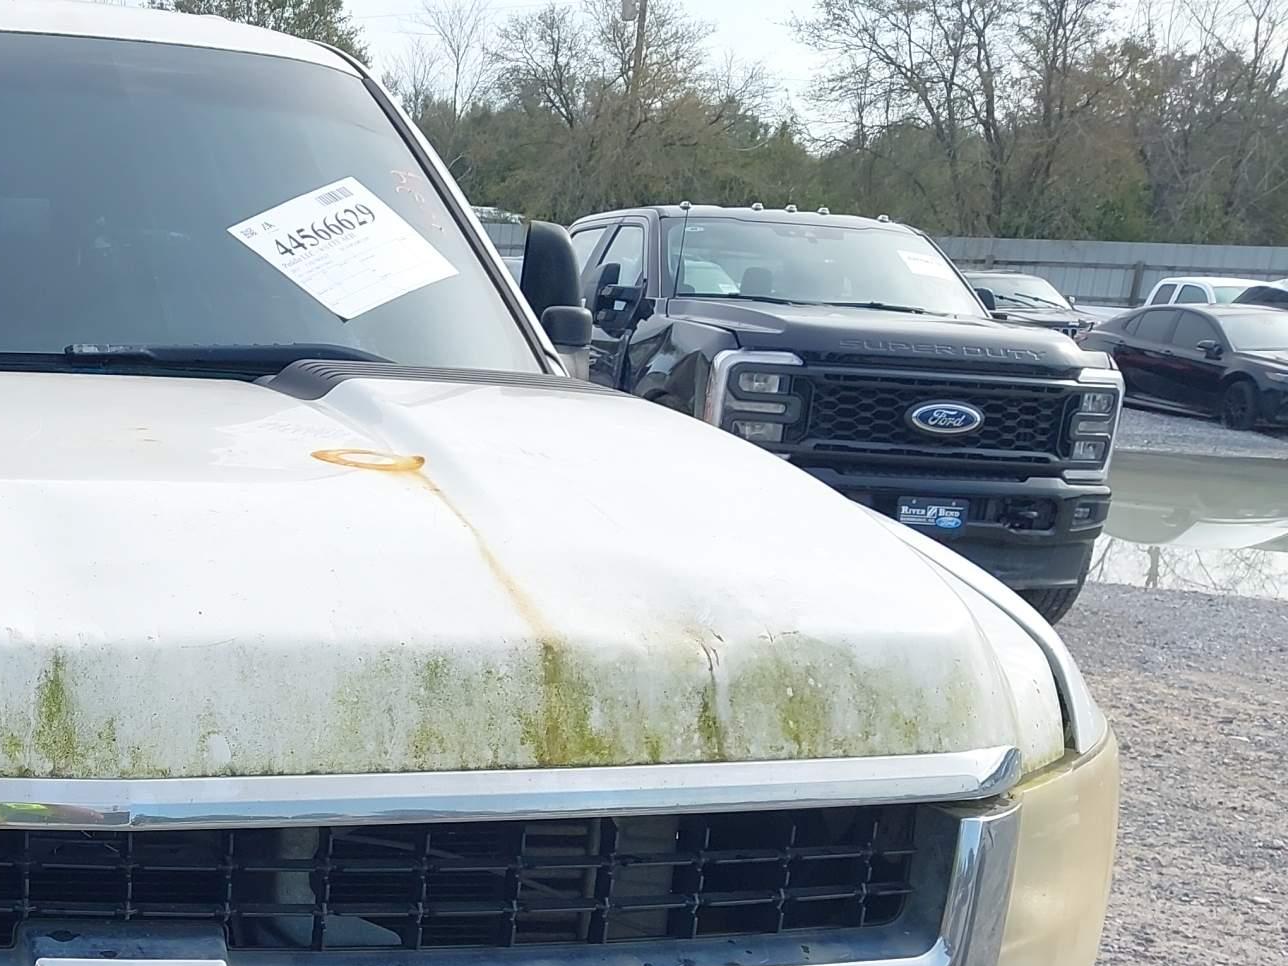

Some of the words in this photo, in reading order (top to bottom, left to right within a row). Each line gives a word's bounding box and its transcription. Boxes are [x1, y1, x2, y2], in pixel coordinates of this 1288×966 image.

[274, 203, 377, 257] 44566629
[839, 339, 955, 356] SUPER
[962, 345, 1047, 361] DUTY
[927, 408, 966, 428] Ford
